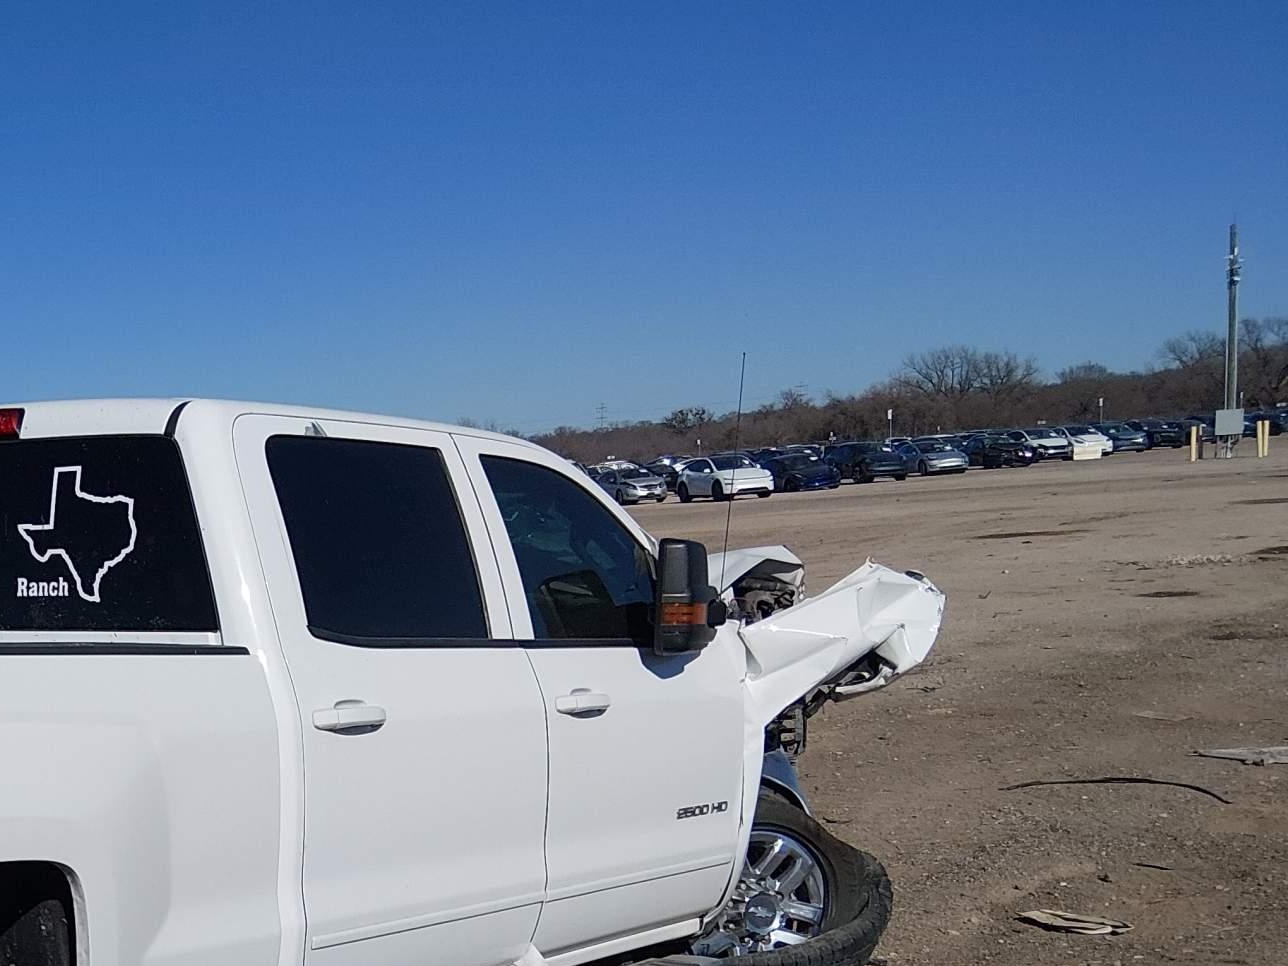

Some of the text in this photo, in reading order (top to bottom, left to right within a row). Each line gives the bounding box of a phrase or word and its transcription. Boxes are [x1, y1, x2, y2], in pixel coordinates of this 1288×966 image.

[17, 577, 69, 597] Ranch
[677, 800, 728, 820] 2500 HD
